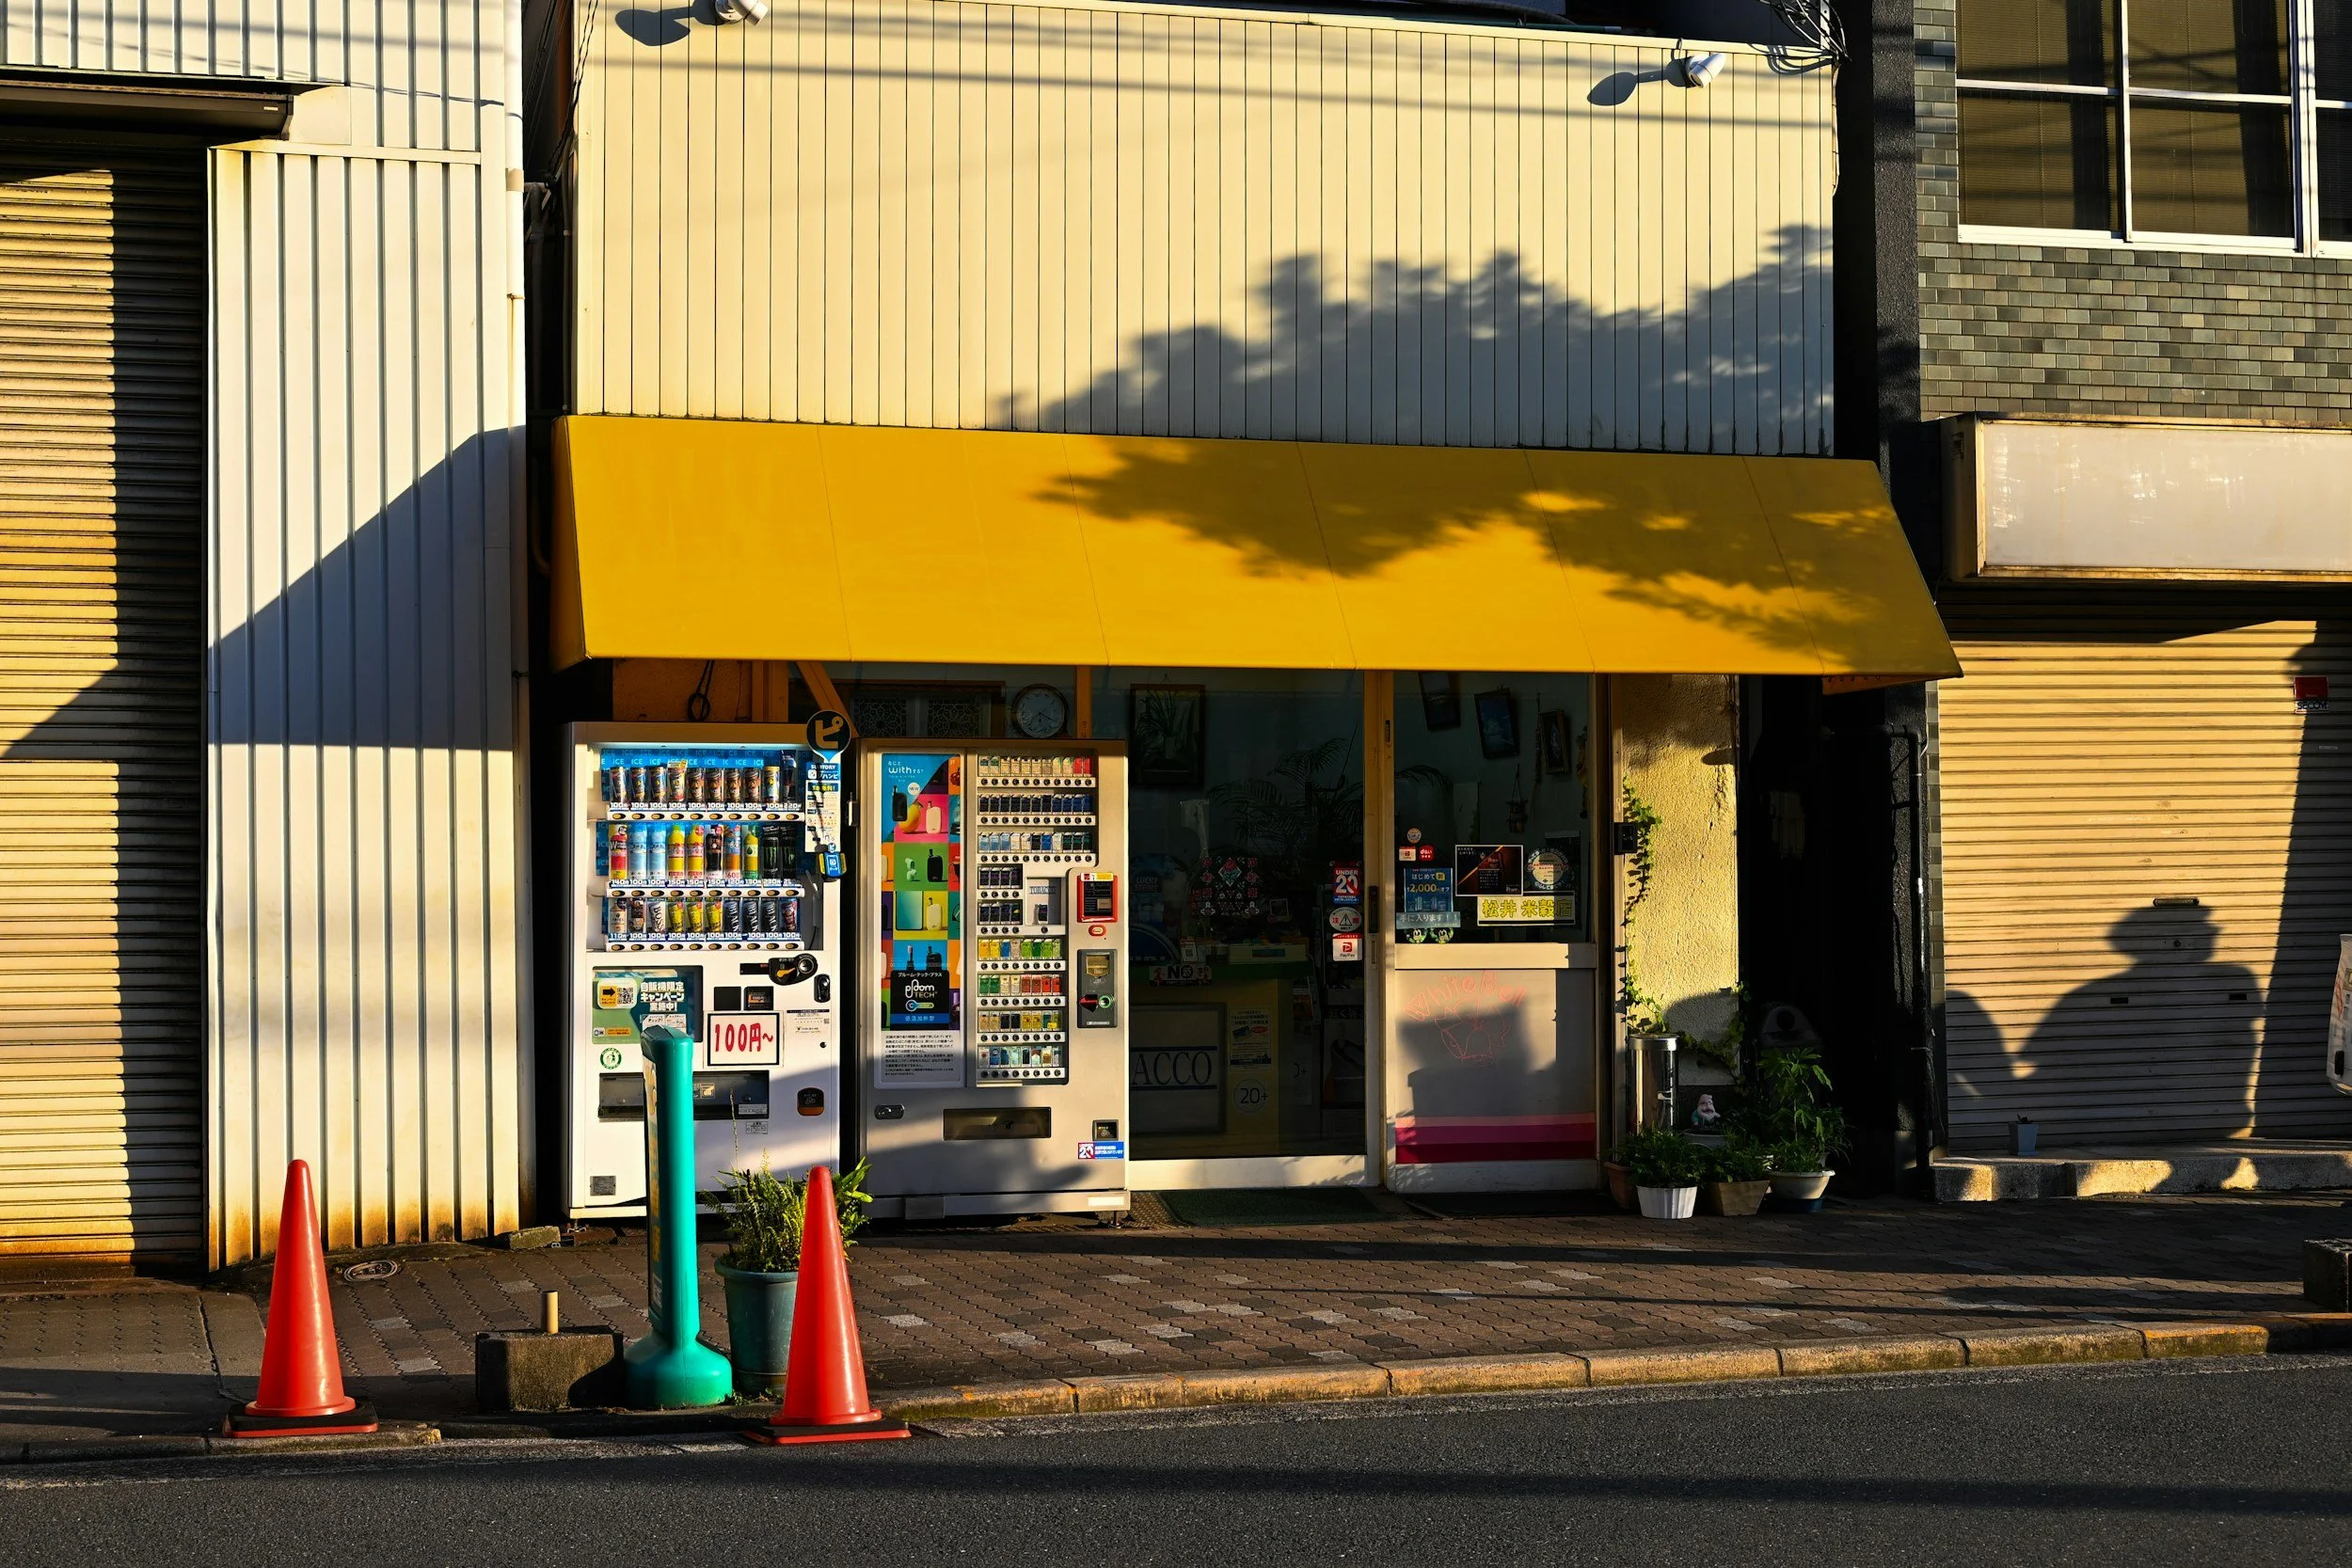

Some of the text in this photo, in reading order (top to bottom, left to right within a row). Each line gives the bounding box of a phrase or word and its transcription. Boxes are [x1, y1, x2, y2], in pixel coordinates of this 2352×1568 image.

[2296, 701, 2329, 709] SECOM
[815, 716, 844, 749] ピ
[1336, 875, 1359, 894] 20
[1482, 898, 1573, 918] 松井 米穀店
[641, 981, 684, 992] 自販機限定
[641, 992, 684, 1003] キャンペーン
[1132, 1052, 1212, 1085] ACCO
[1241, 1087, 1269, 1104] 20+
